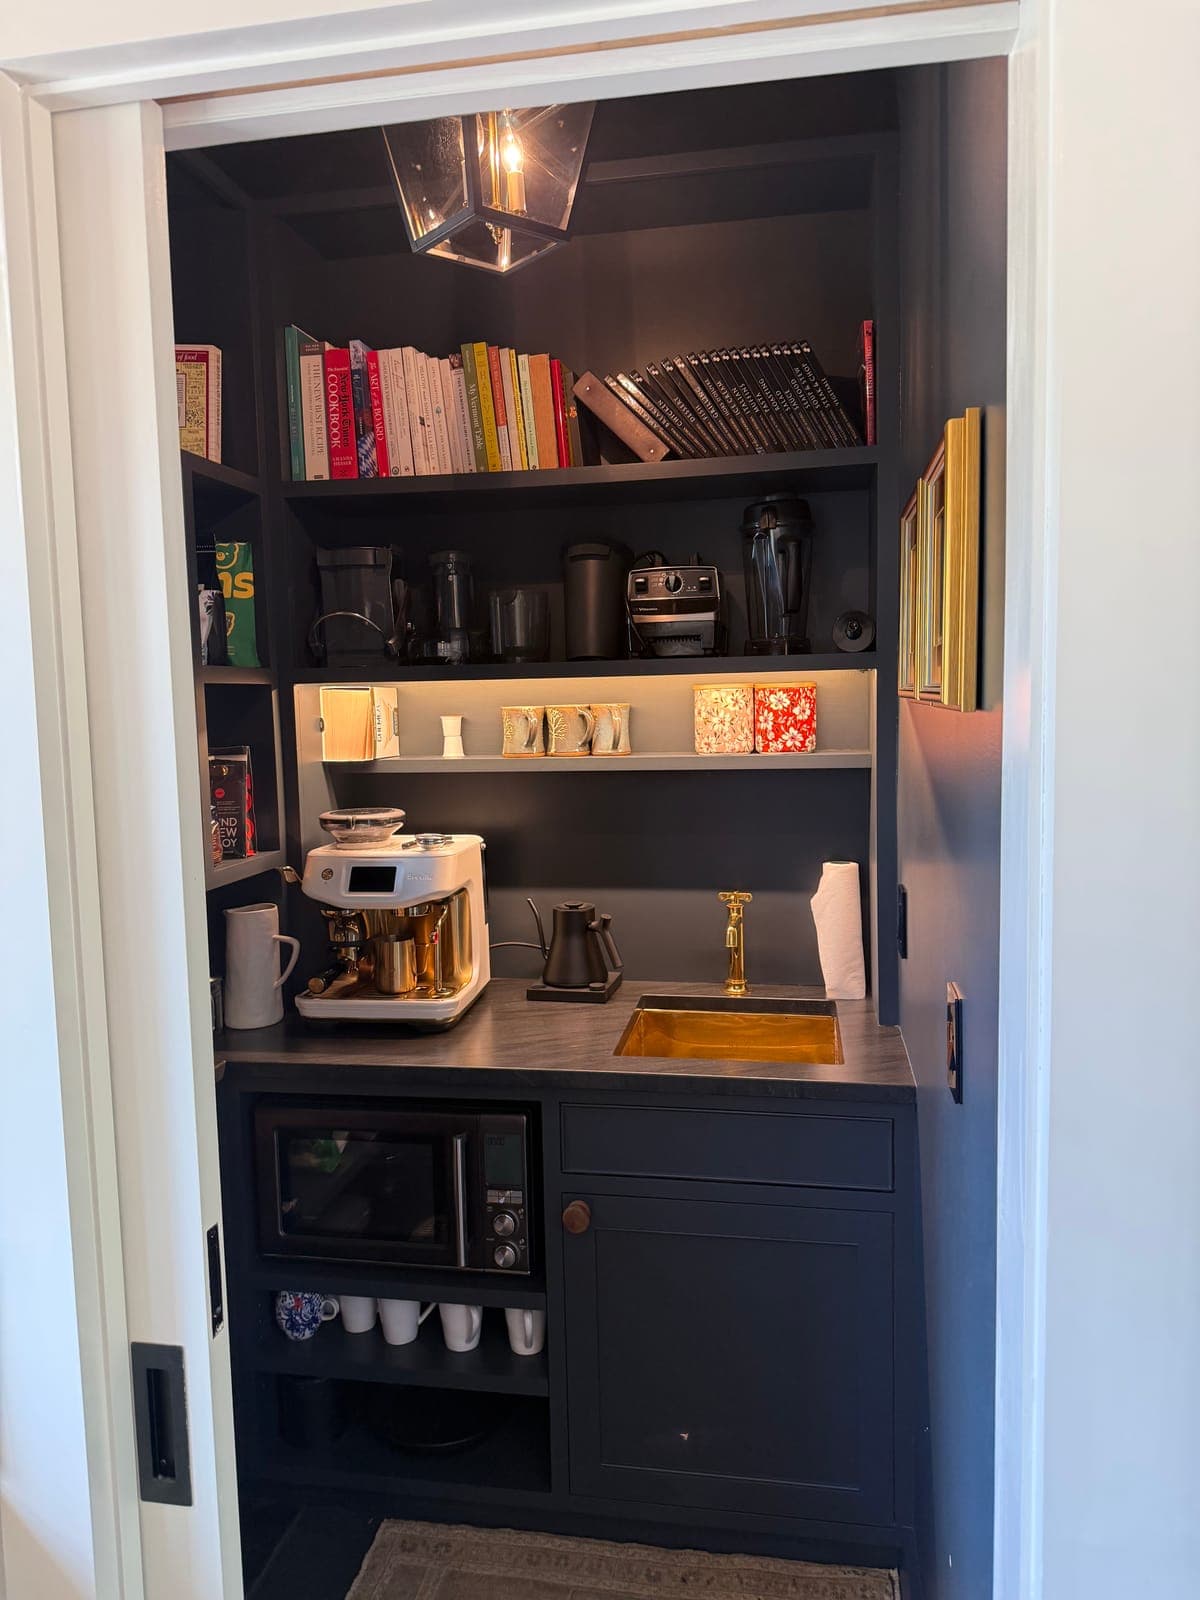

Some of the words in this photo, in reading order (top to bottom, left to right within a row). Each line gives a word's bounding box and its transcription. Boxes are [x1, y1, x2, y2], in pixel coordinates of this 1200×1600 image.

[312, 363, 320, 380] THE
[340, 373, 348, 393] New
[792, 365, 807, 385] STEW
[800, 361, 816, 382] CHOP
[313, 382, 321, 401] NEW
[469, 383, 477, 395] My
[715, 379, 734, 403] CREAM
[731, 386, 751, 415] ITALIAN
[739, 382, 760, 413] MUFFINS
[757, 377, 781, 411] ROASTING
[774, 388, 791, 411] SALAD
[784, 388, 799, 410] SAUCE
[789, 377, 810, 409] SEAFOOD
[807, 390, 821, 409] SOUP
[815, 386, 831, 408] STEAK
[822, 377, 840, 406] VEGETABLE
[328, 373, 341, 448] COOKBOOK
[339, 393, 350, 418] York
[370, 373, 379, 390] ART
[375, 408, 384, 440] BOARD
[470, 396, 481, 428] Vermont
[656, 398, 683, 426] CHICKEN
[672, 395, 696, 422] DESSERT
[694, 385, 720, 418] GRILLING
[694, 404, 708, 420] FISH
[731, 403, 741, 415] ICE
[755, 391, 770, 412] PASTA
[314, 404, 322, 424] BEST
[315, 426, 323, 455] RECIPE
[340, 419, 351, 447] Times
[474, 429, 484, 449] Table
